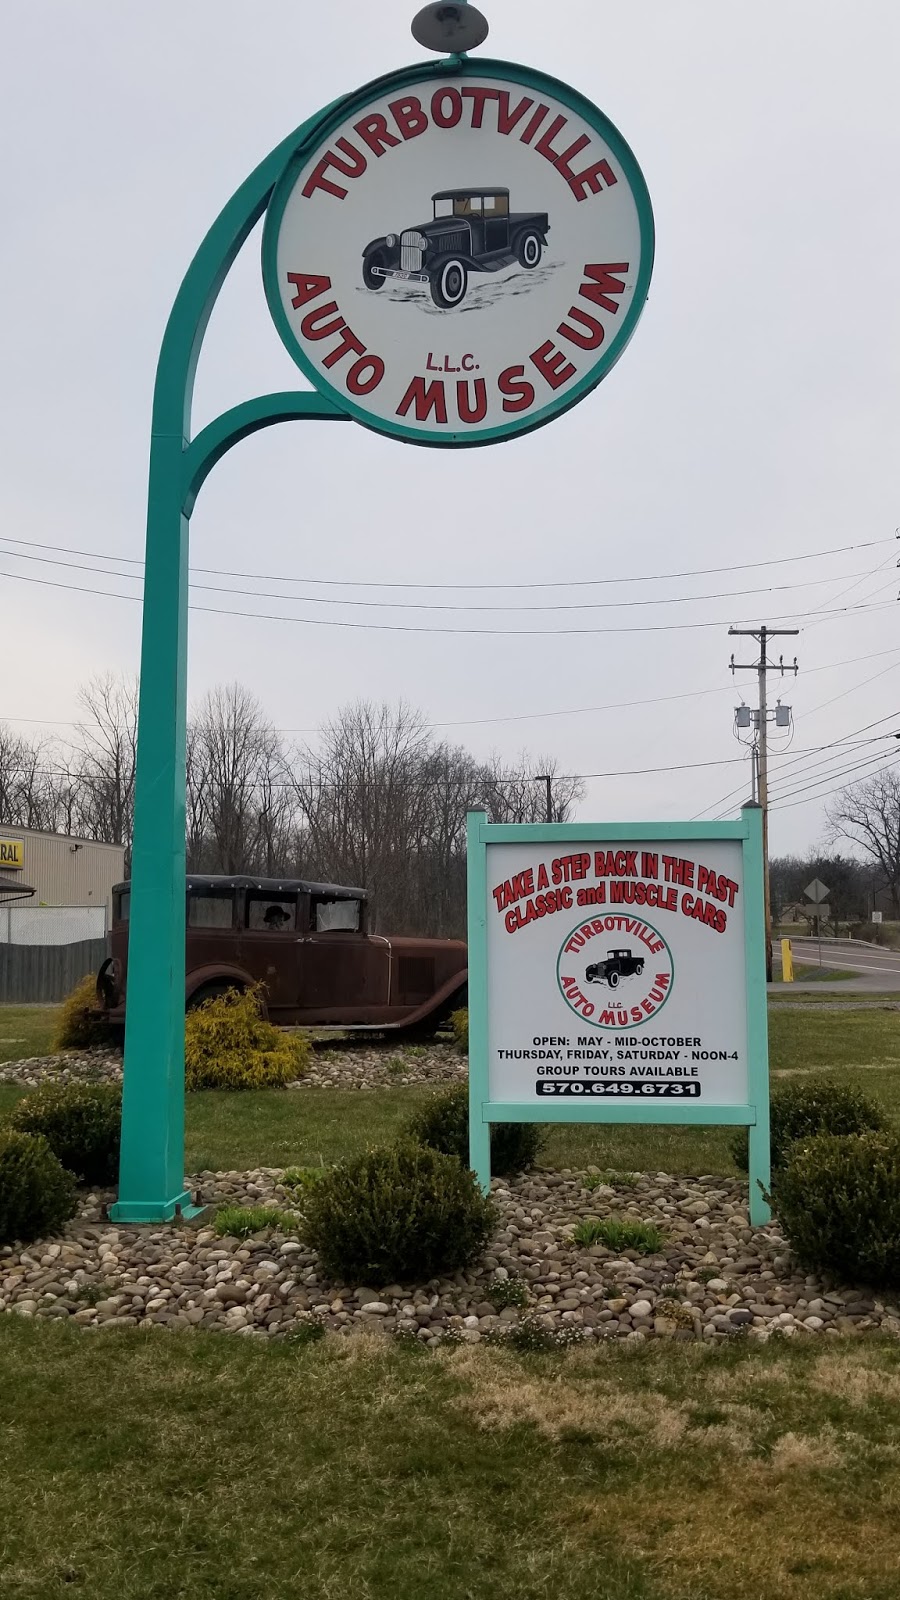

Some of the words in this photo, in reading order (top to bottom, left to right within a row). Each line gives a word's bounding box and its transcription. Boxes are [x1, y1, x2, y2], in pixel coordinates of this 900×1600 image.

[301, 86, 618, 202] TURBOTVILLE
[287, 271, 385, 396] AUTO
[395, 262, 630, 424] MUSEUM
[426, 352, 480, 373] L.L.C.
[492, 867, 535, 913] TAKE
[537, 863, 550, 891] A
[551, 852, 591, 885] STEP
[594, 850, 639, 878] BACK
[641, 851, 659, 880] IN
[662, 854, 695, 888] THE
[697, 864, 739, 908] PAST
[504, 886, 573, 934] CLASSIC
[576, 881, 606, 907] and
[610, 880, 679, 912] MUSCLE
[681, 892, 727, 934] CARS
[563, 916, 666, 954] TURBOTVILLE
[561, 976, 595, 1017] AUTO
[598, 973, 671, 1025] MUSEUM
[497, 1050, 563, 1061] THURSDAY,
[567, 1050, 613, 1061] FRIDAY,
[617, 1050, 680, 1060] SATURDAY
[692, 1051, 739, 1060] NOON-4
[532, 1036, 570, 1046] OPEN:
[577, 1036, 603, 1046] MAY
[615, 1037, 702, 1047] MID-OCTOBER
[536, 1066, 580, 1076] GROUP
[583, 1066, 626, 1076] TOURS
[629, 1066, 699, 1077] AVAILABLE
[542, 1082, 697, 1094] 570.649.6731
